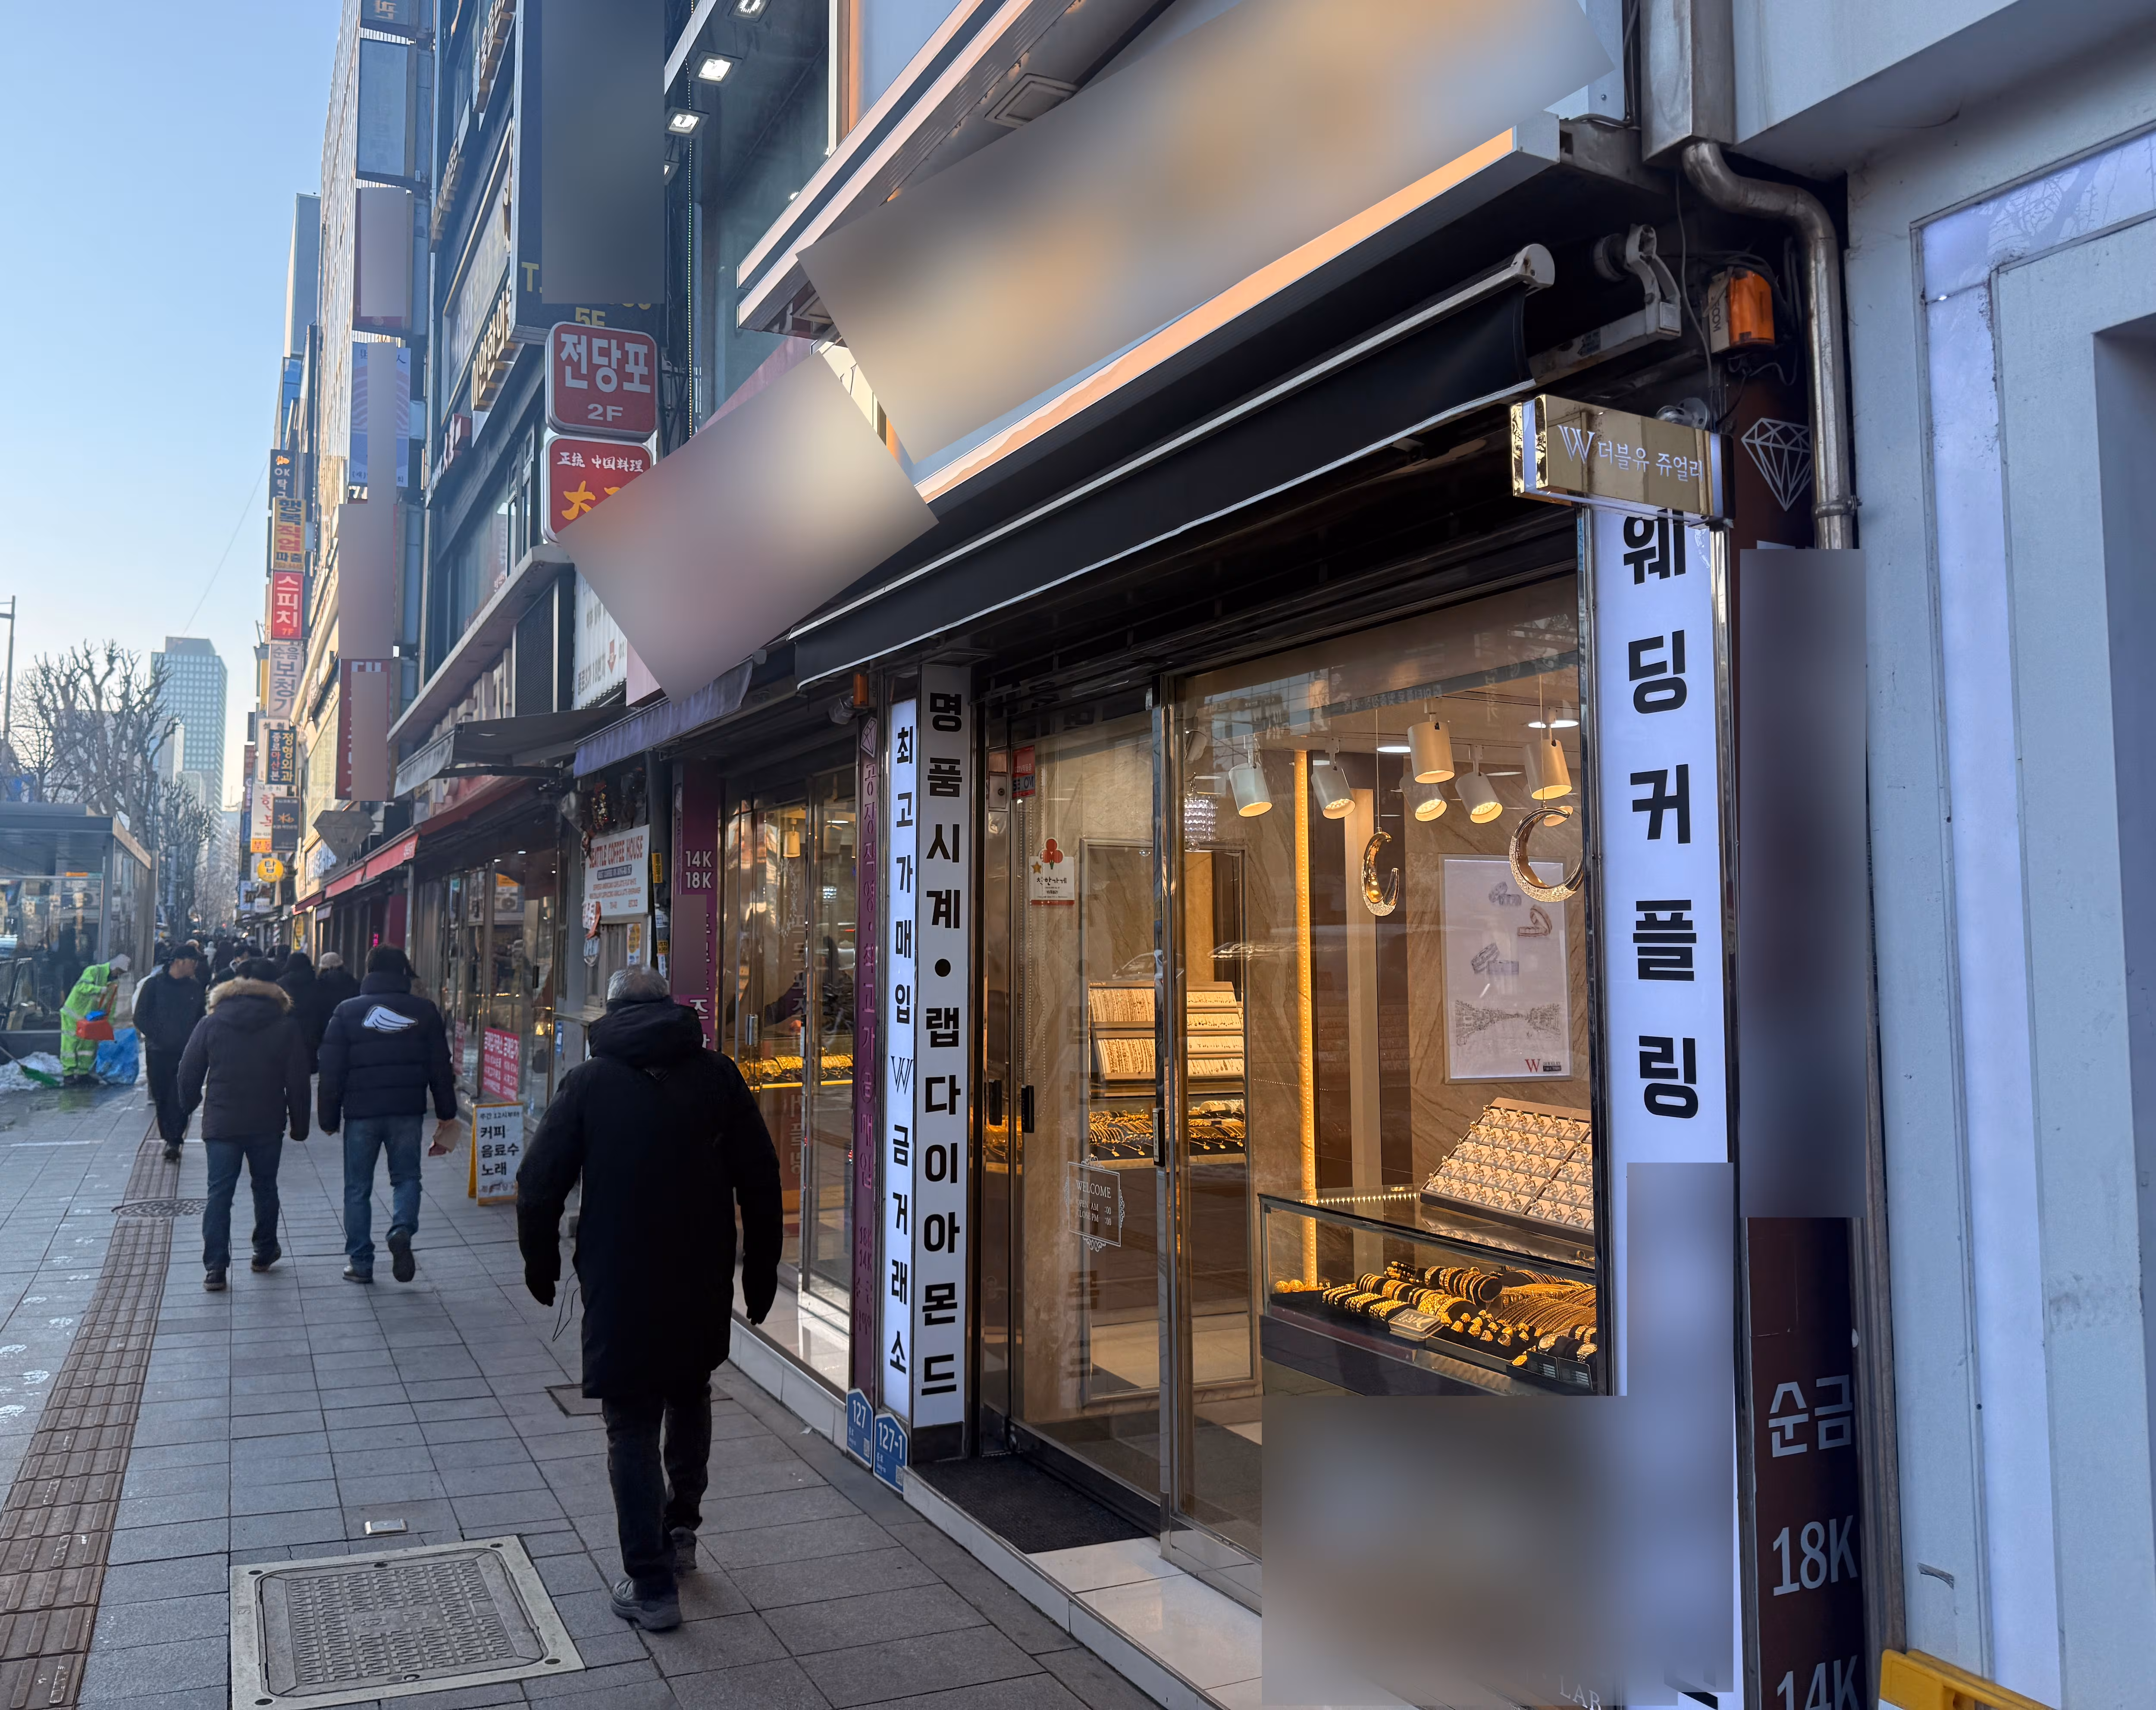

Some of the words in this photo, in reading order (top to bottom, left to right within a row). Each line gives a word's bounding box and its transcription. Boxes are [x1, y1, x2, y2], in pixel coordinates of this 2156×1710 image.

[561, 333, 651, 393] 전당포
[587, 404, 624, 422] 2F
[1557, 424, 1595, 464] W
[1598, 441, 1650, 473] 더블유
[1656, 452, 1704, 482] 쥬얼리
[557, 452, 586, 467] 正统
[591, 454, 644, 473] 中国料理
[274, 468, 290, 476] OK
[276, 576, 299, 627] 스피치
[282, 628, 295, 636] 7F
[273, 660, 297, 711] 보청기
[281, 733, 294, 783] 정형외과
[608, 840, 625, 865] COFFEE
[627, 835, 643, 861] HOUSE
[686, 850, 712, 868] 14K
[686, 872, 712, 889] 18K
[1037, 877, 1067, 886] 착한가게
[1525, 1059, 1541, 1073] W
[481, 1125, 506, 1139] 커피
[481, 1143, 520, 1158] 음료수
[482, 1162, 506, 1176] 노래
[1076, 1180, 1111, 1198] WELCOME
[1091, 1203, 1099, 1211] AM
[1092, 1213, 1099, 1222] PM
[853, 1400, 866, 1429] 127
[1768, 1374, 1853, 1457] 순금
[879, 1422, 903, 1460] 127-1
[1773, 1515, 1858, 1596] 18K
[1777, 1655, 1859, 1710] 14K
